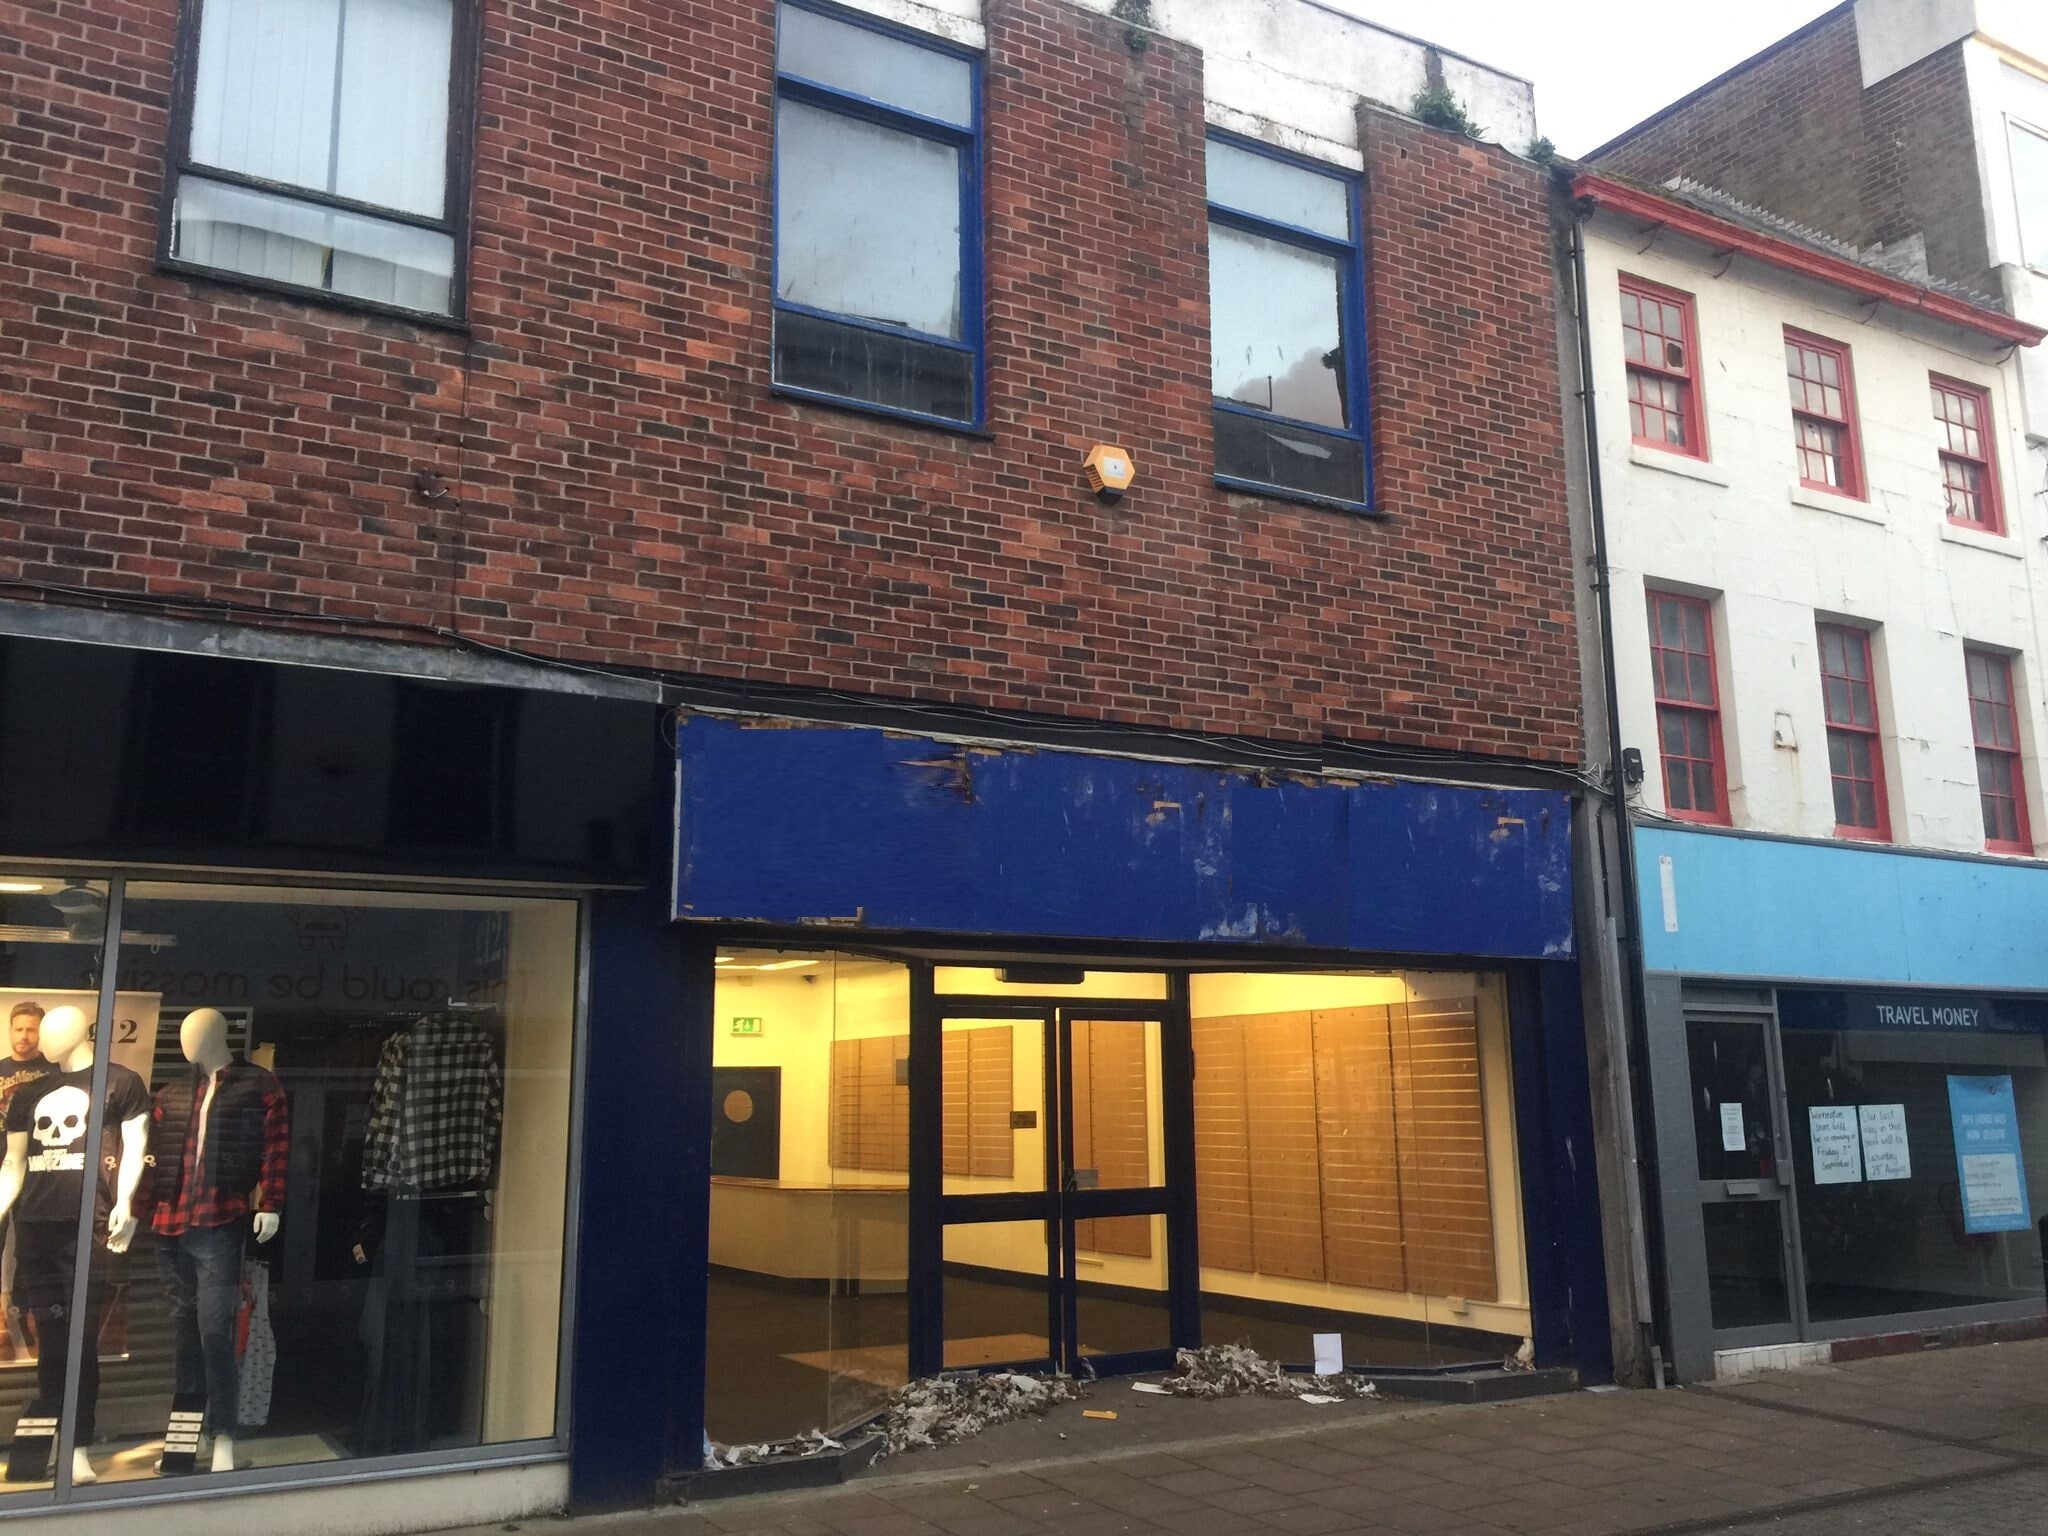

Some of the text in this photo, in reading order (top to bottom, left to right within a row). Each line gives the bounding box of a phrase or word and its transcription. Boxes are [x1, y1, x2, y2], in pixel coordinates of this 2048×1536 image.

[1876, 1005, 1979, 1026] TRAVEL MONEY
[87, 1018, 138, 1044] £2
[1817, 1145, 1839, 1161] Friday
